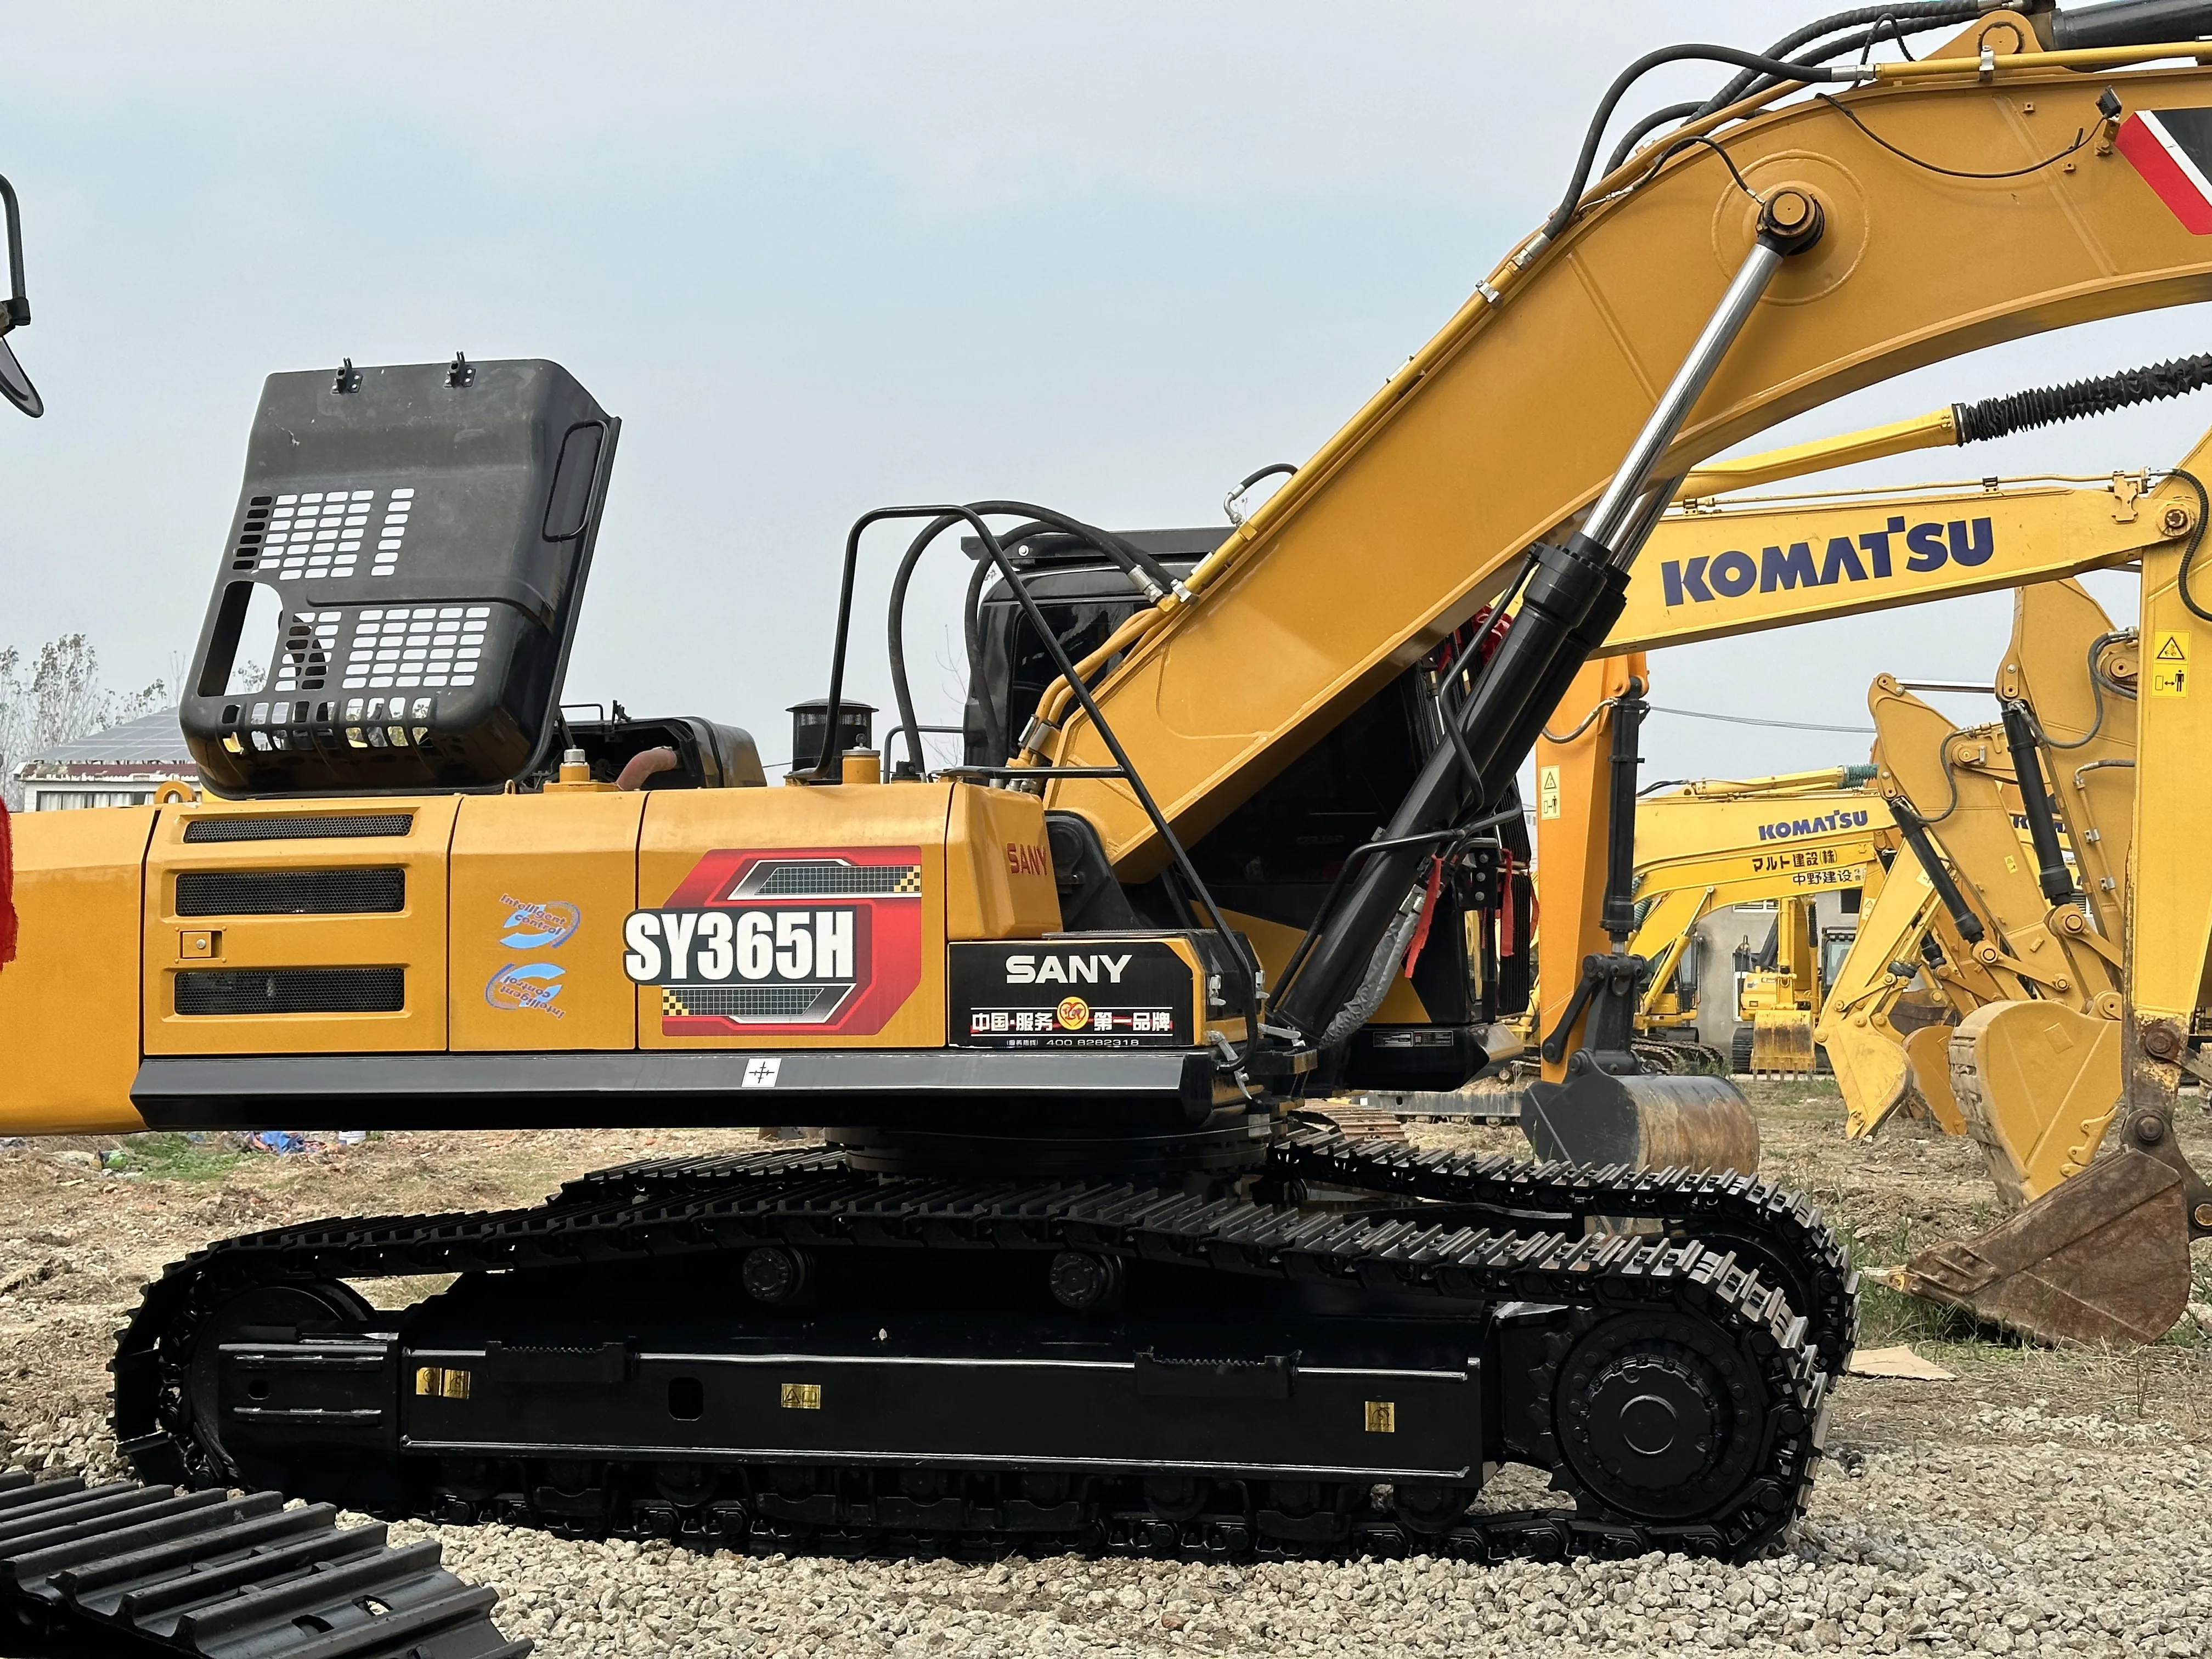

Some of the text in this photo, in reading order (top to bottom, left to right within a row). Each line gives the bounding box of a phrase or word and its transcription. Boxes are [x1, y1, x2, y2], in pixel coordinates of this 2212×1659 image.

[1661, 516, 1994, 607] KOMATSU
[1758, 810, 1868, 840] KOMATSU
[1007, 843, 1047, 876] SANY
[625, 911, 854, 981] SY365H
[1006, 955, 1132, 984] SANY
[1094, 1012, 1171, 1031] 第一品牌
